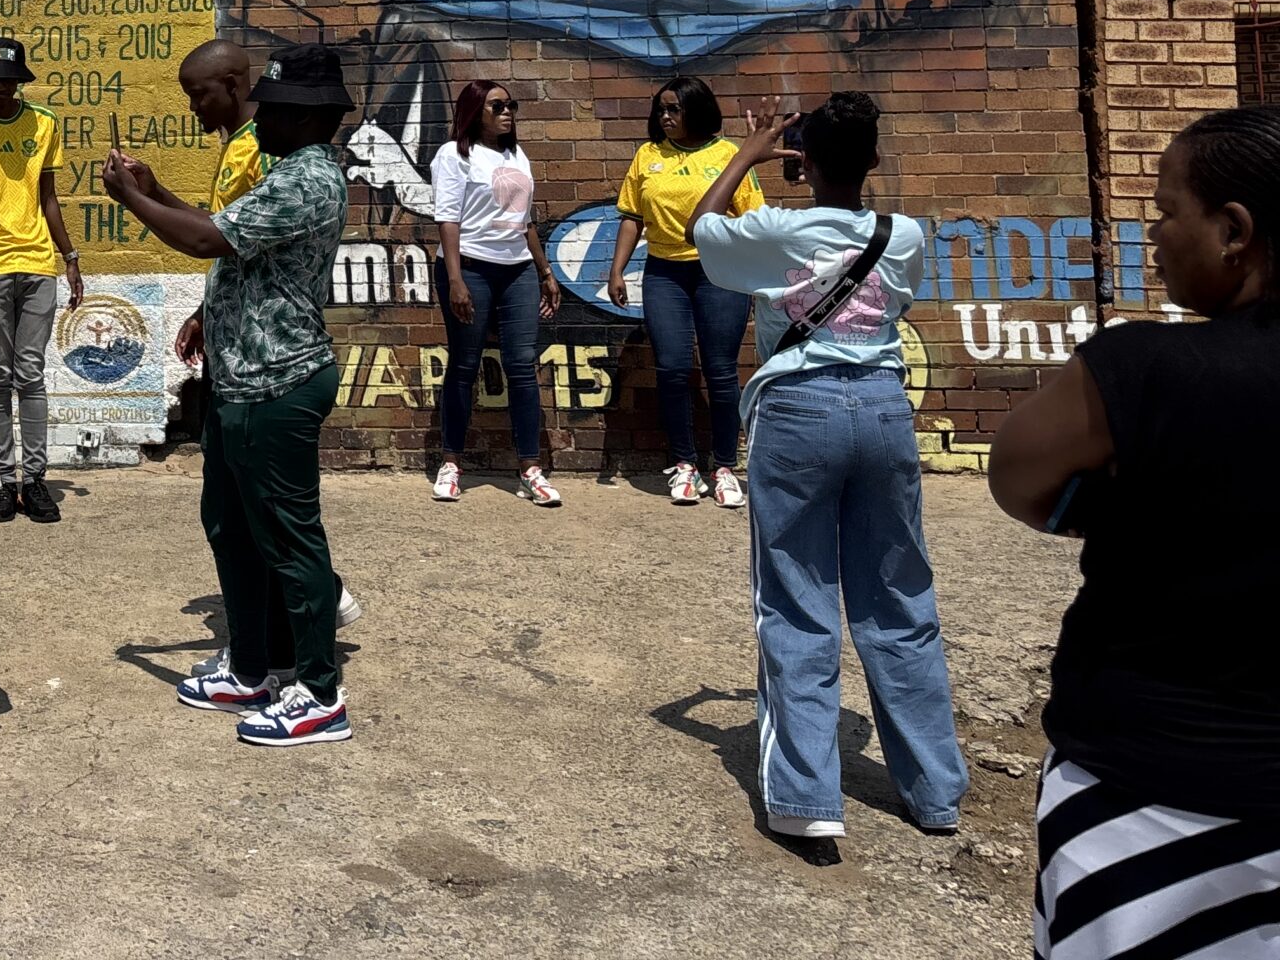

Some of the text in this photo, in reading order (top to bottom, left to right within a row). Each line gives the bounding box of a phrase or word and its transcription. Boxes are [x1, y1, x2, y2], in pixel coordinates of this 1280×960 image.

[29, 24, 91, 62] 2015
[118, 23, 172, 60] 2019
[46, 70, 125, 106] 2004
[538, 343, 613, 409] 15
